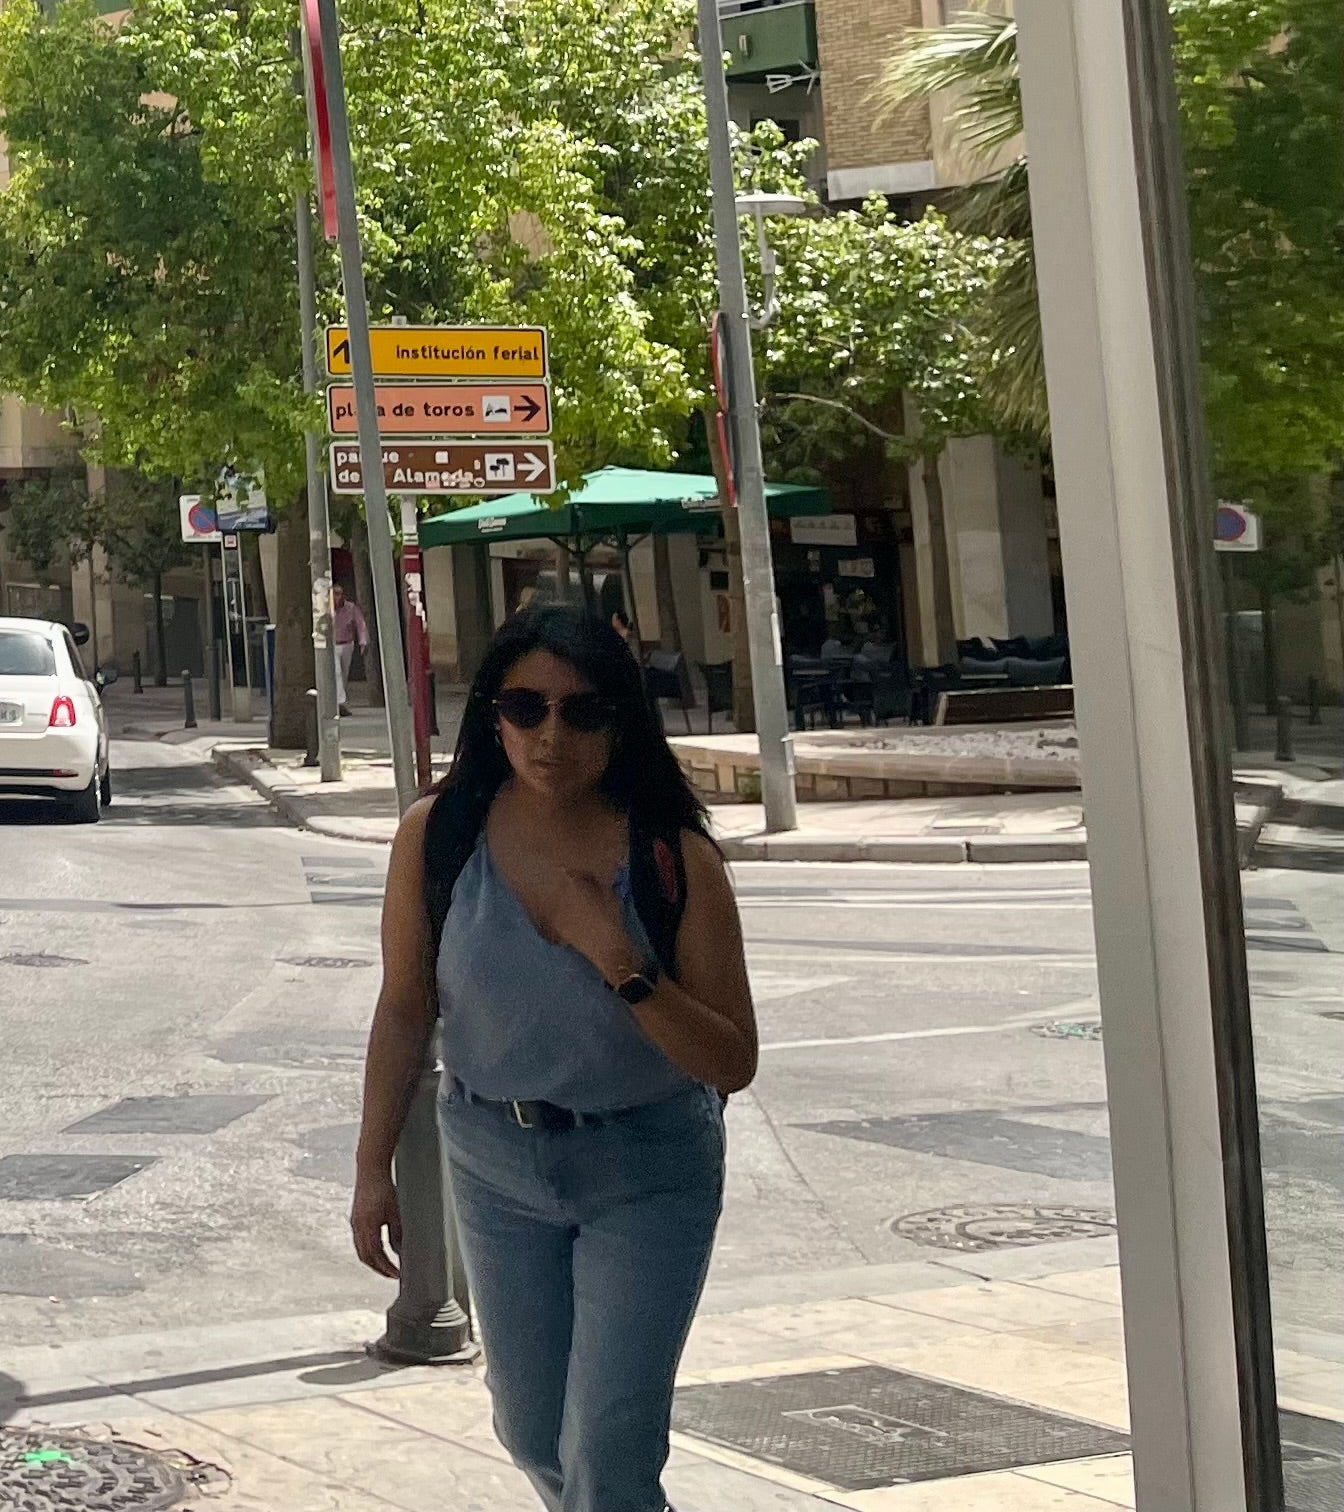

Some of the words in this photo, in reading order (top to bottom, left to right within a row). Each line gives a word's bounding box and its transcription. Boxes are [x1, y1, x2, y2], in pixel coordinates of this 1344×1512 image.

[493, 345, 539, 360] ferial
[336, 402, 386, 420] pla
[392, 402, 415, 417] de
[424, 402, 475, 417] toros
[337, 469, 360, 483] de
